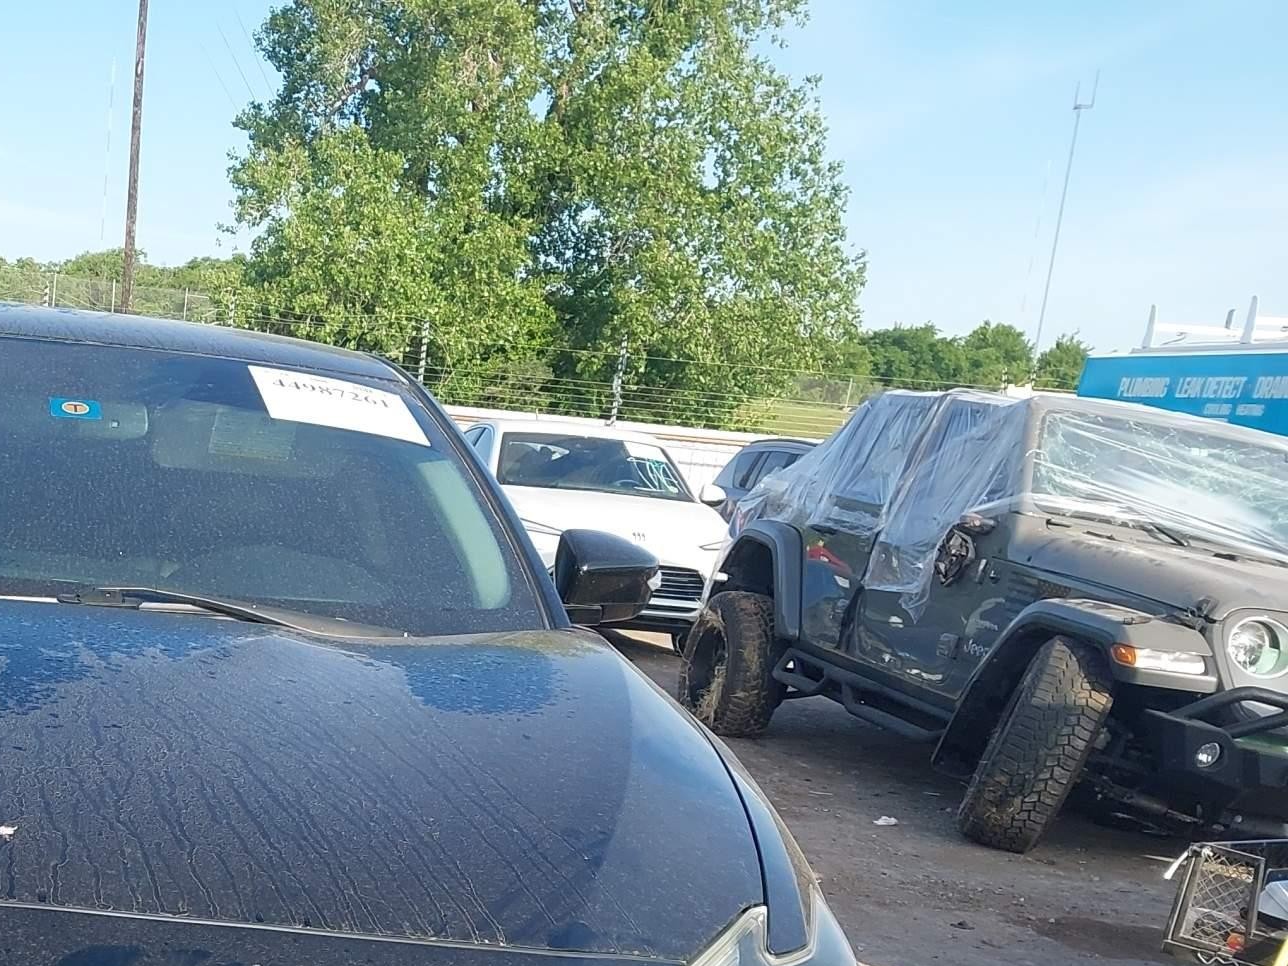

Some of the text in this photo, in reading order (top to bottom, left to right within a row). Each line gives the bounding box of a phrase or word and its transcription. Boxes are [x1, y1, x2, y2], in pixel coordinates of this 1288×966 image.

[273, 378, 390, 409] 44987261
[1117, 376, 1171, 398] PLUMBING
[1175, 376, 1206, 398] LEAK
[1202, 376, 1248, 398] DETECT
